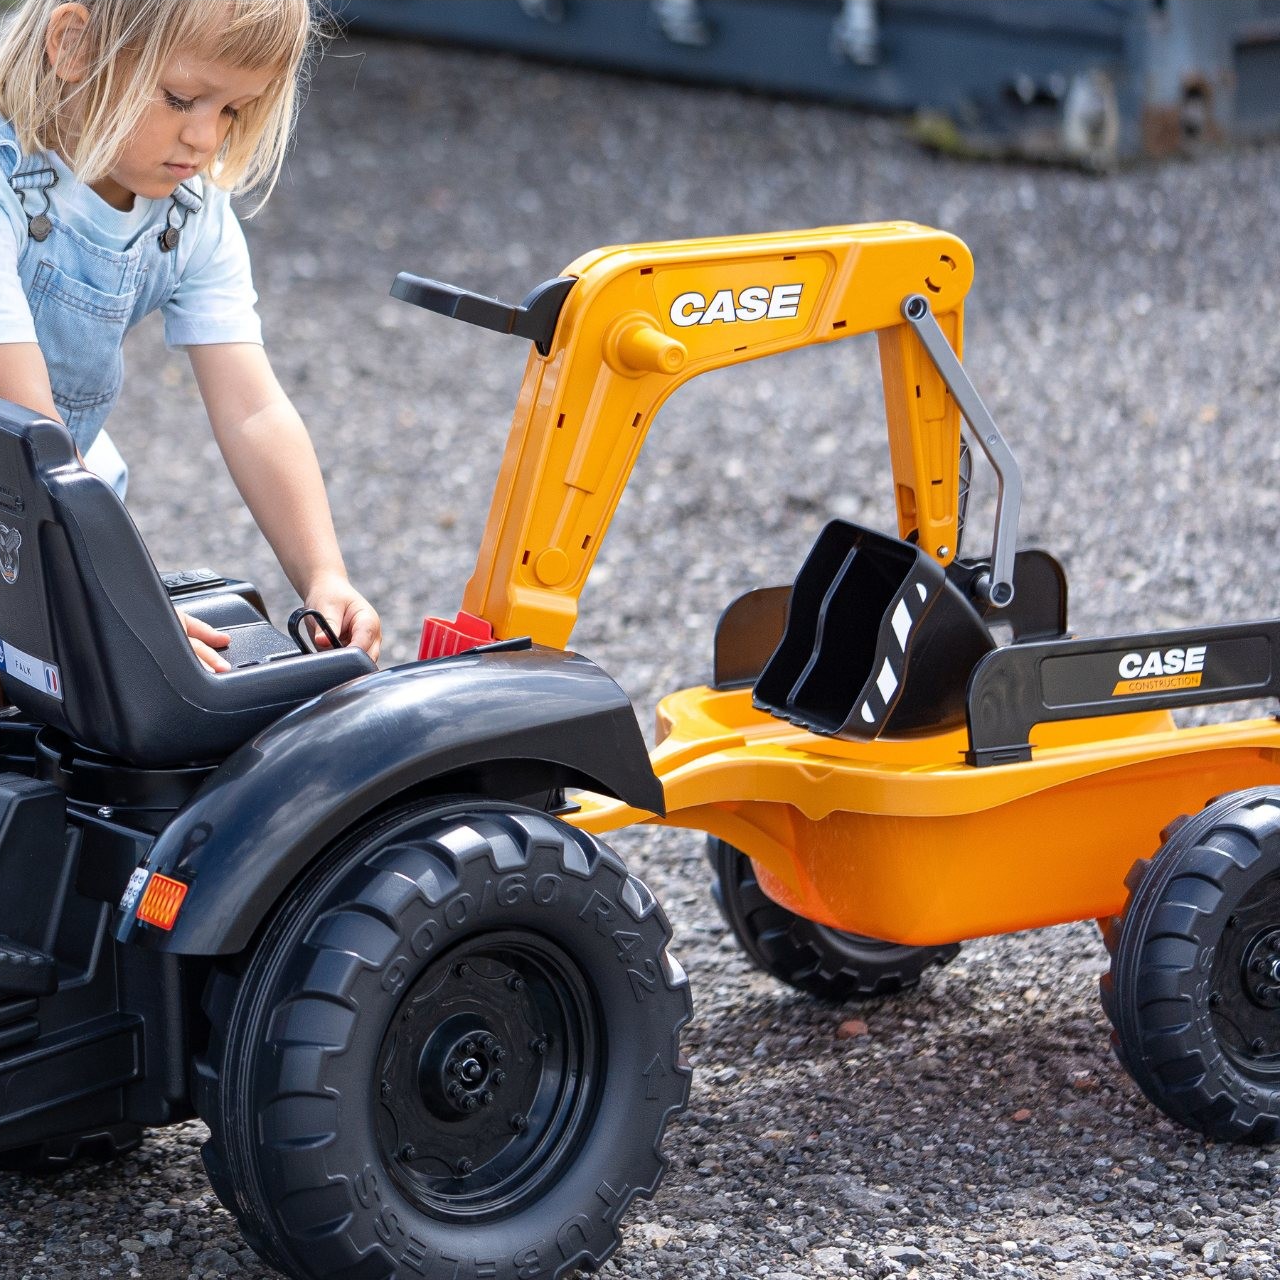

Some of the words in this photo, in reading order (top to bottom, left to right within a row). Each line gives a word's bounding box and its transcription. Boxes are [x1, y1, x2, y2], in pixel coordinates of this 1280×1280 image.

[669, 283, 804, 327] CASE
[15, 660, 32, 677] FALK
[1118, 645, 1207, 679] CASE
[1128, 676, 1199, 691] CONSTRUCTION
[578, 888, 660, 1003] R42
